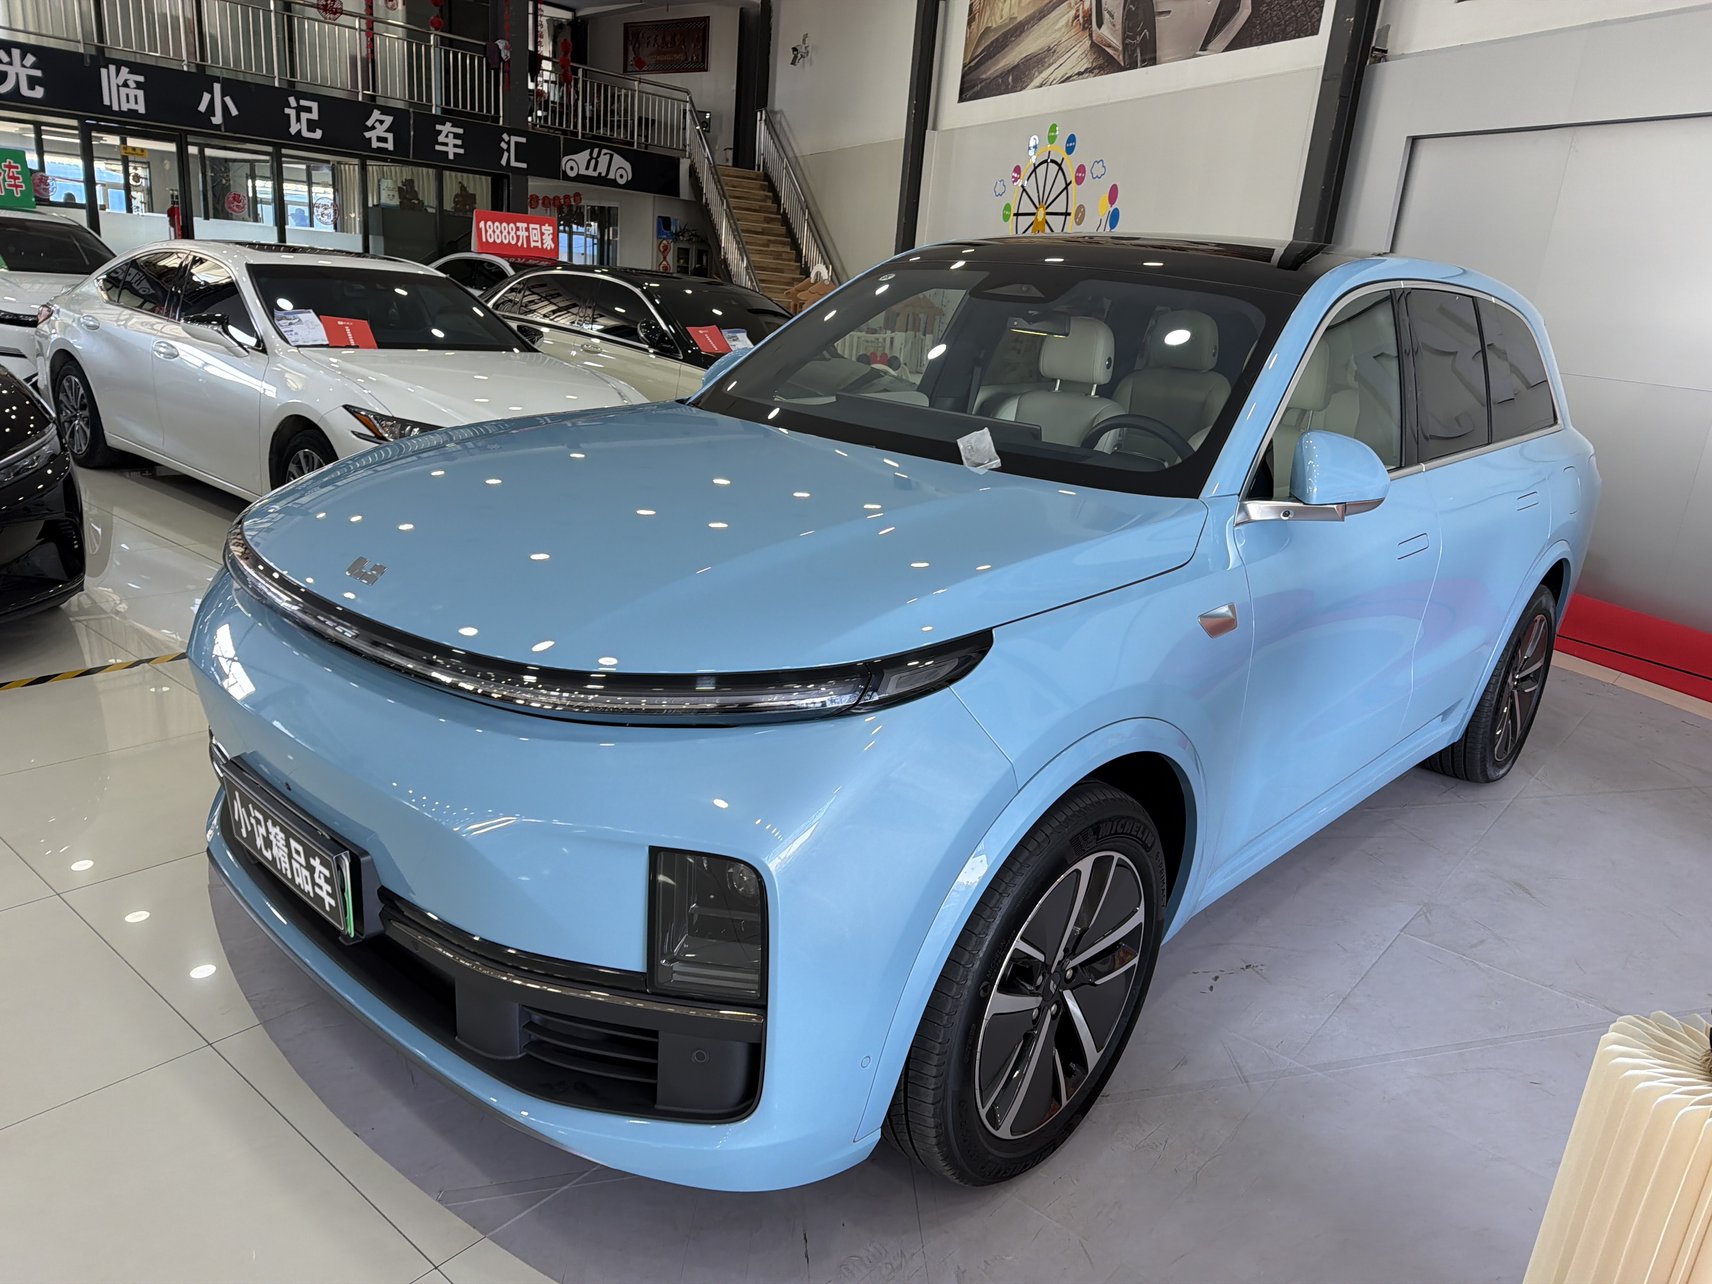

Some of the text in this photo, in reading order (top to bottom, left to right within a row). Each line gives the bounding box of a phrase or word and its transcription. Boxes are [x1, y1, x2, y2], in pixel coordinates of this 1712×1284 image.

[0, 159, 25, 197] 车
[479, 220, 555, 251] 18888开回家
[1098, 820, 1155, 848] MICHELIN
[233, 791, 336, 912] 小记精品车
